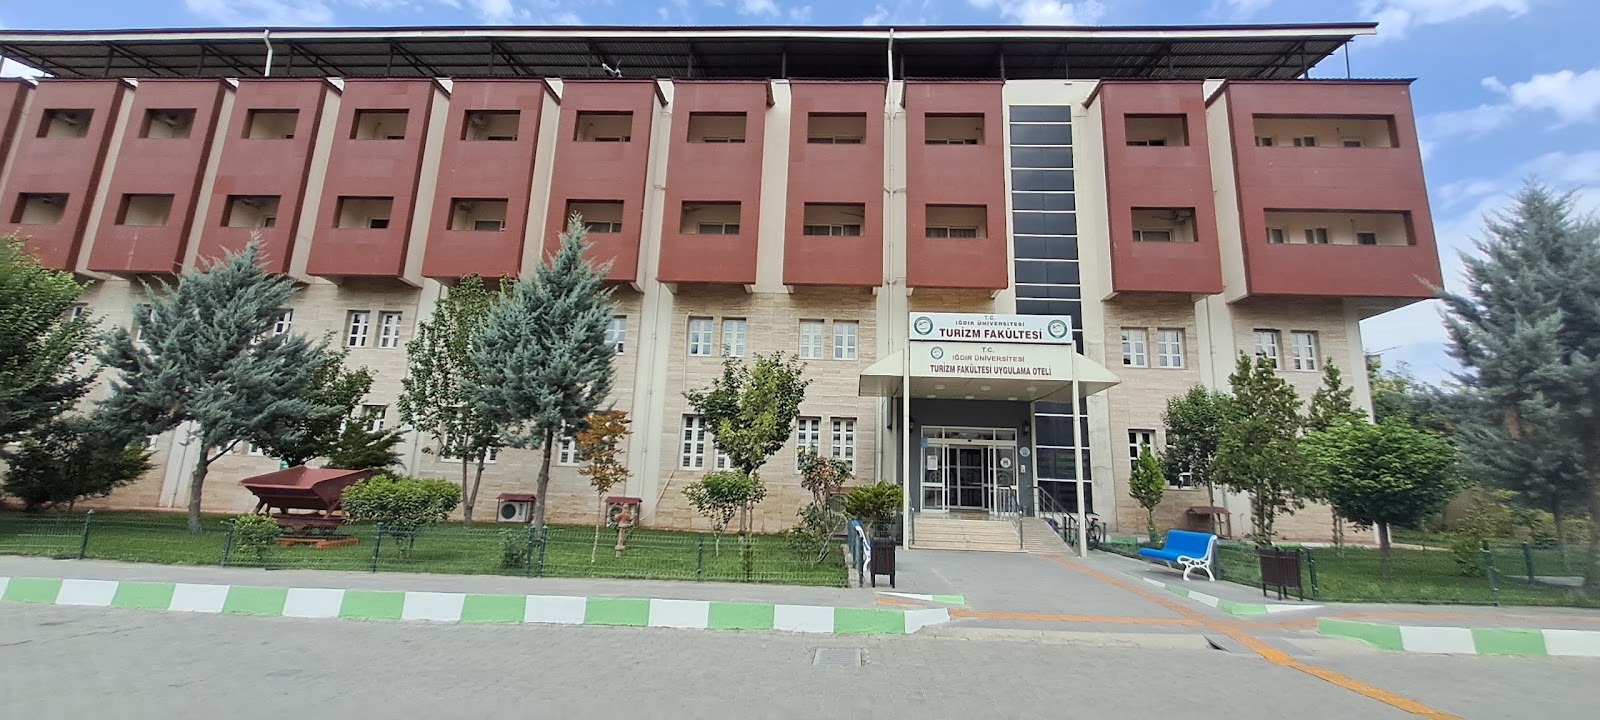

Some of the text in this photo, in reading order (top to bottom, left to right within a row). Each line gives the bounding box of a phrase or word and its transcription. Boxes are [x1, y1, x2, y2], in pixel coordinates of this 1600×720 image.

[939, 326, 1042, 340] TURİZM FAKÜLTESİ
[974, 355, 1025, 363] ÜNİVERSİTESİ
[930, 363, 1052, 376] TURİZM FAKÜLTESİ UYGULAMA OTELİ
